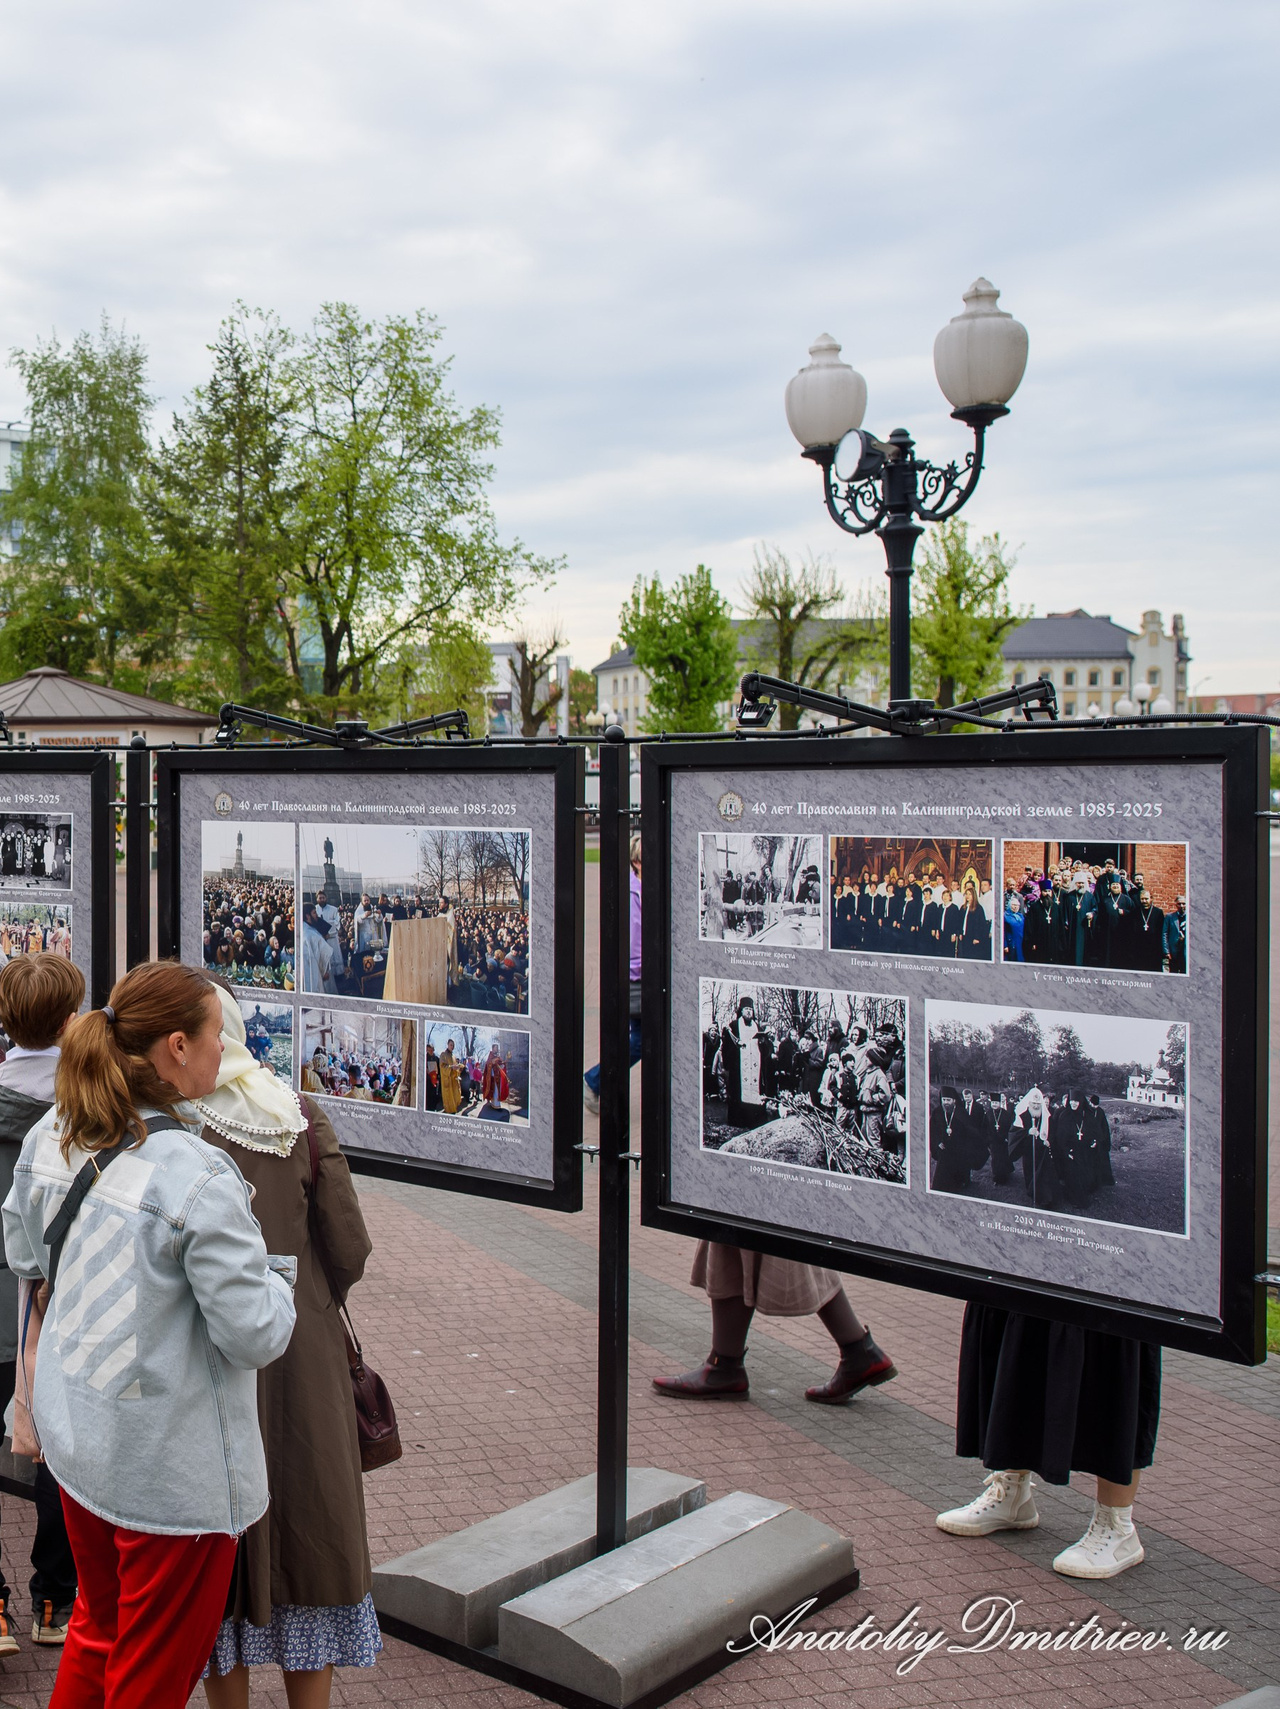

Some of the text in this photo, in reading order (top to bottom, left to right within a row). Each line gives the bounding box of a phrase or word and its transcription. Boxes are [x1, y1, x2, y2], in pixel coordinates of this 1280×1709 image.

[14, 793, 60, 805] 1985-2025
[238, 800, 517, 818] 40 лет Православия на Калининградской земле 1985-2025
[751, 801, 1163, 822] 40 лет Православия на Калининградской земле 1985-2025
[724, 946, 796, 960] 1987 Поднятие креста
[730, 956, 790, 970] Никольского храма
[850, 957, 965, 976] Первый хор Никольского храма
[1033, 971, 1041, 982] У
[1043, 973, 1063, 983] стен
[1065, 975, 1092, 985] храма
[1101, 977, 1152, 989] пастырями
[376, 1005, 444, 1019] Праздник Крещения 90-е
[453, 1118, 482, 1130] Крестный
[749, 1165, 765, 1176] 1992
[766, 1168, 799, 1182] Панихида
[806, 1177, 823, 1187] день
[825, 1179, 853, 1192] Победы
[1014, 1214, 1086, 1236] 2010 Монастырь
[979, 1220, 985, 1228] в
[1046, 1231, 1075, 1245] Визит
[1077, 1237, 1125, 1255] Патриарха
